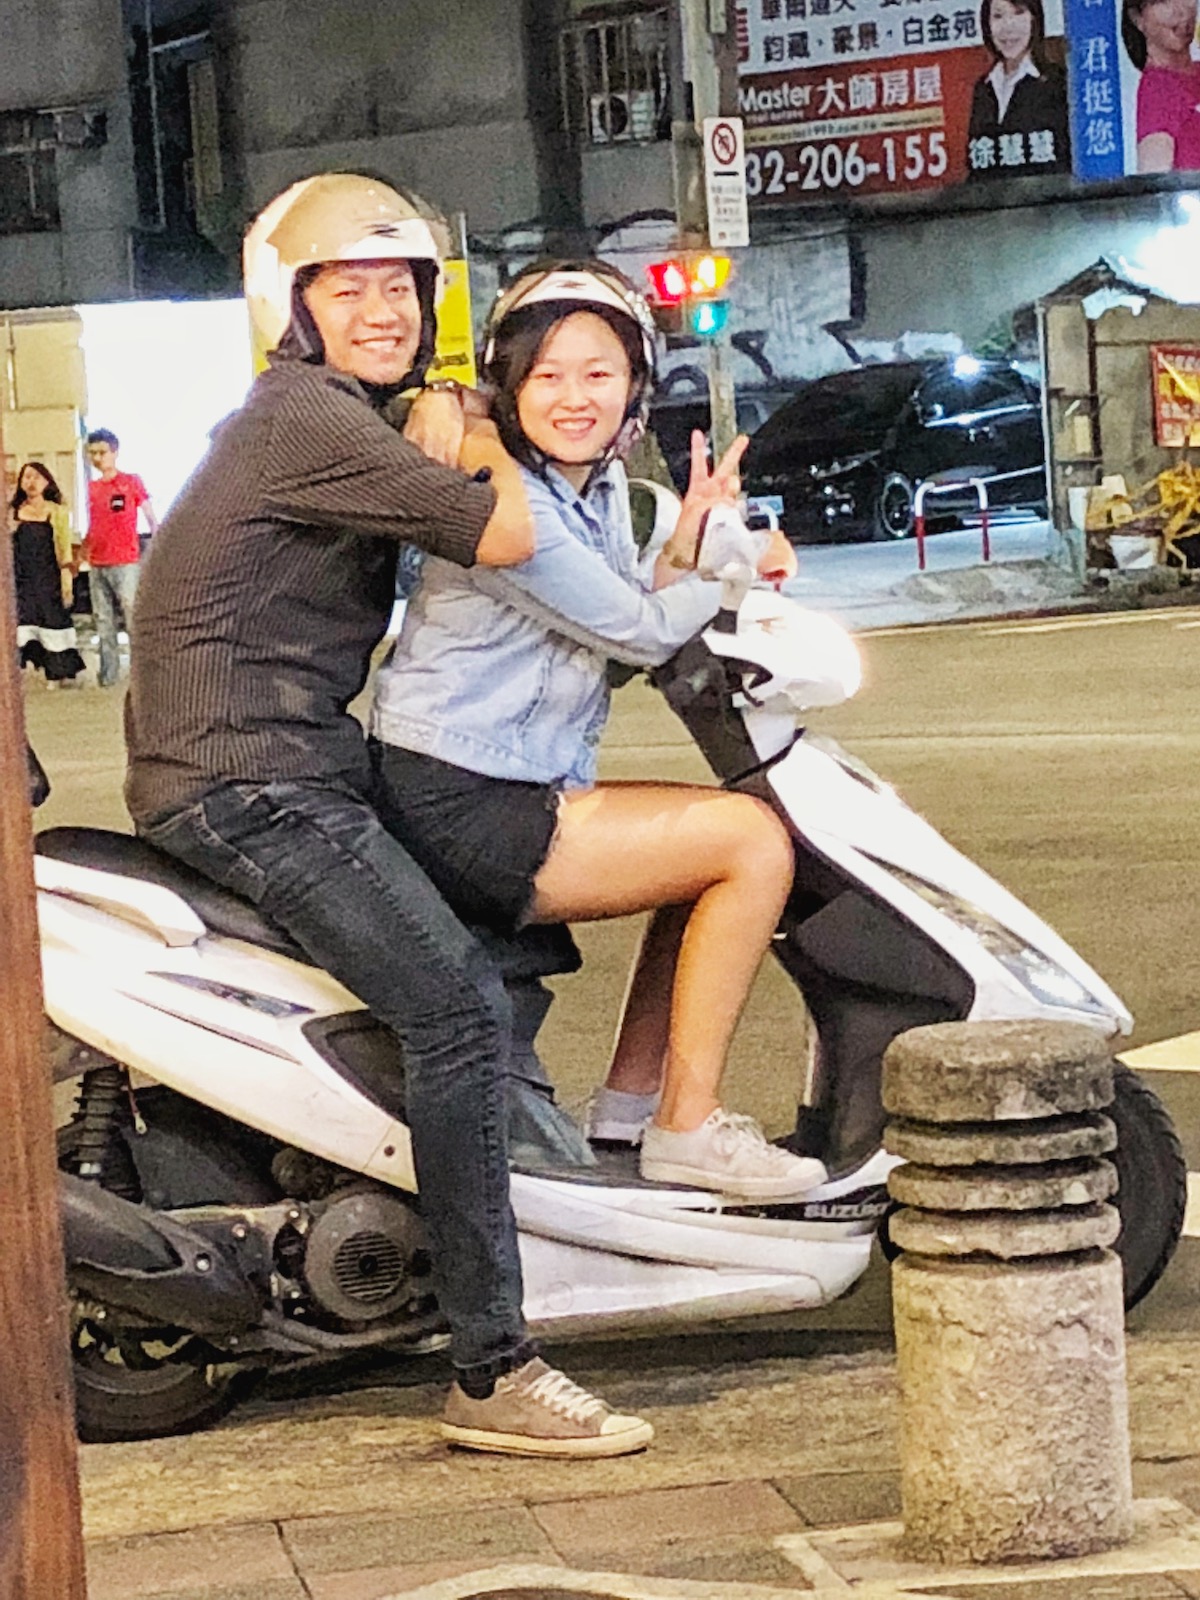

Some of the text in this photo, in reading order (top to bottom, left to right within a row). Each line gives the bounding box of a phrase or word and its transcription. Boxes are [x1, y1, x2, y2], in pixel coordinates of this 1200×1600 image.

[738, 64, 944, 115] Master 大師房屋
[1081, 36, 1115, 156] 君挺您
[744, 132, 948, 196] 32-206-155
